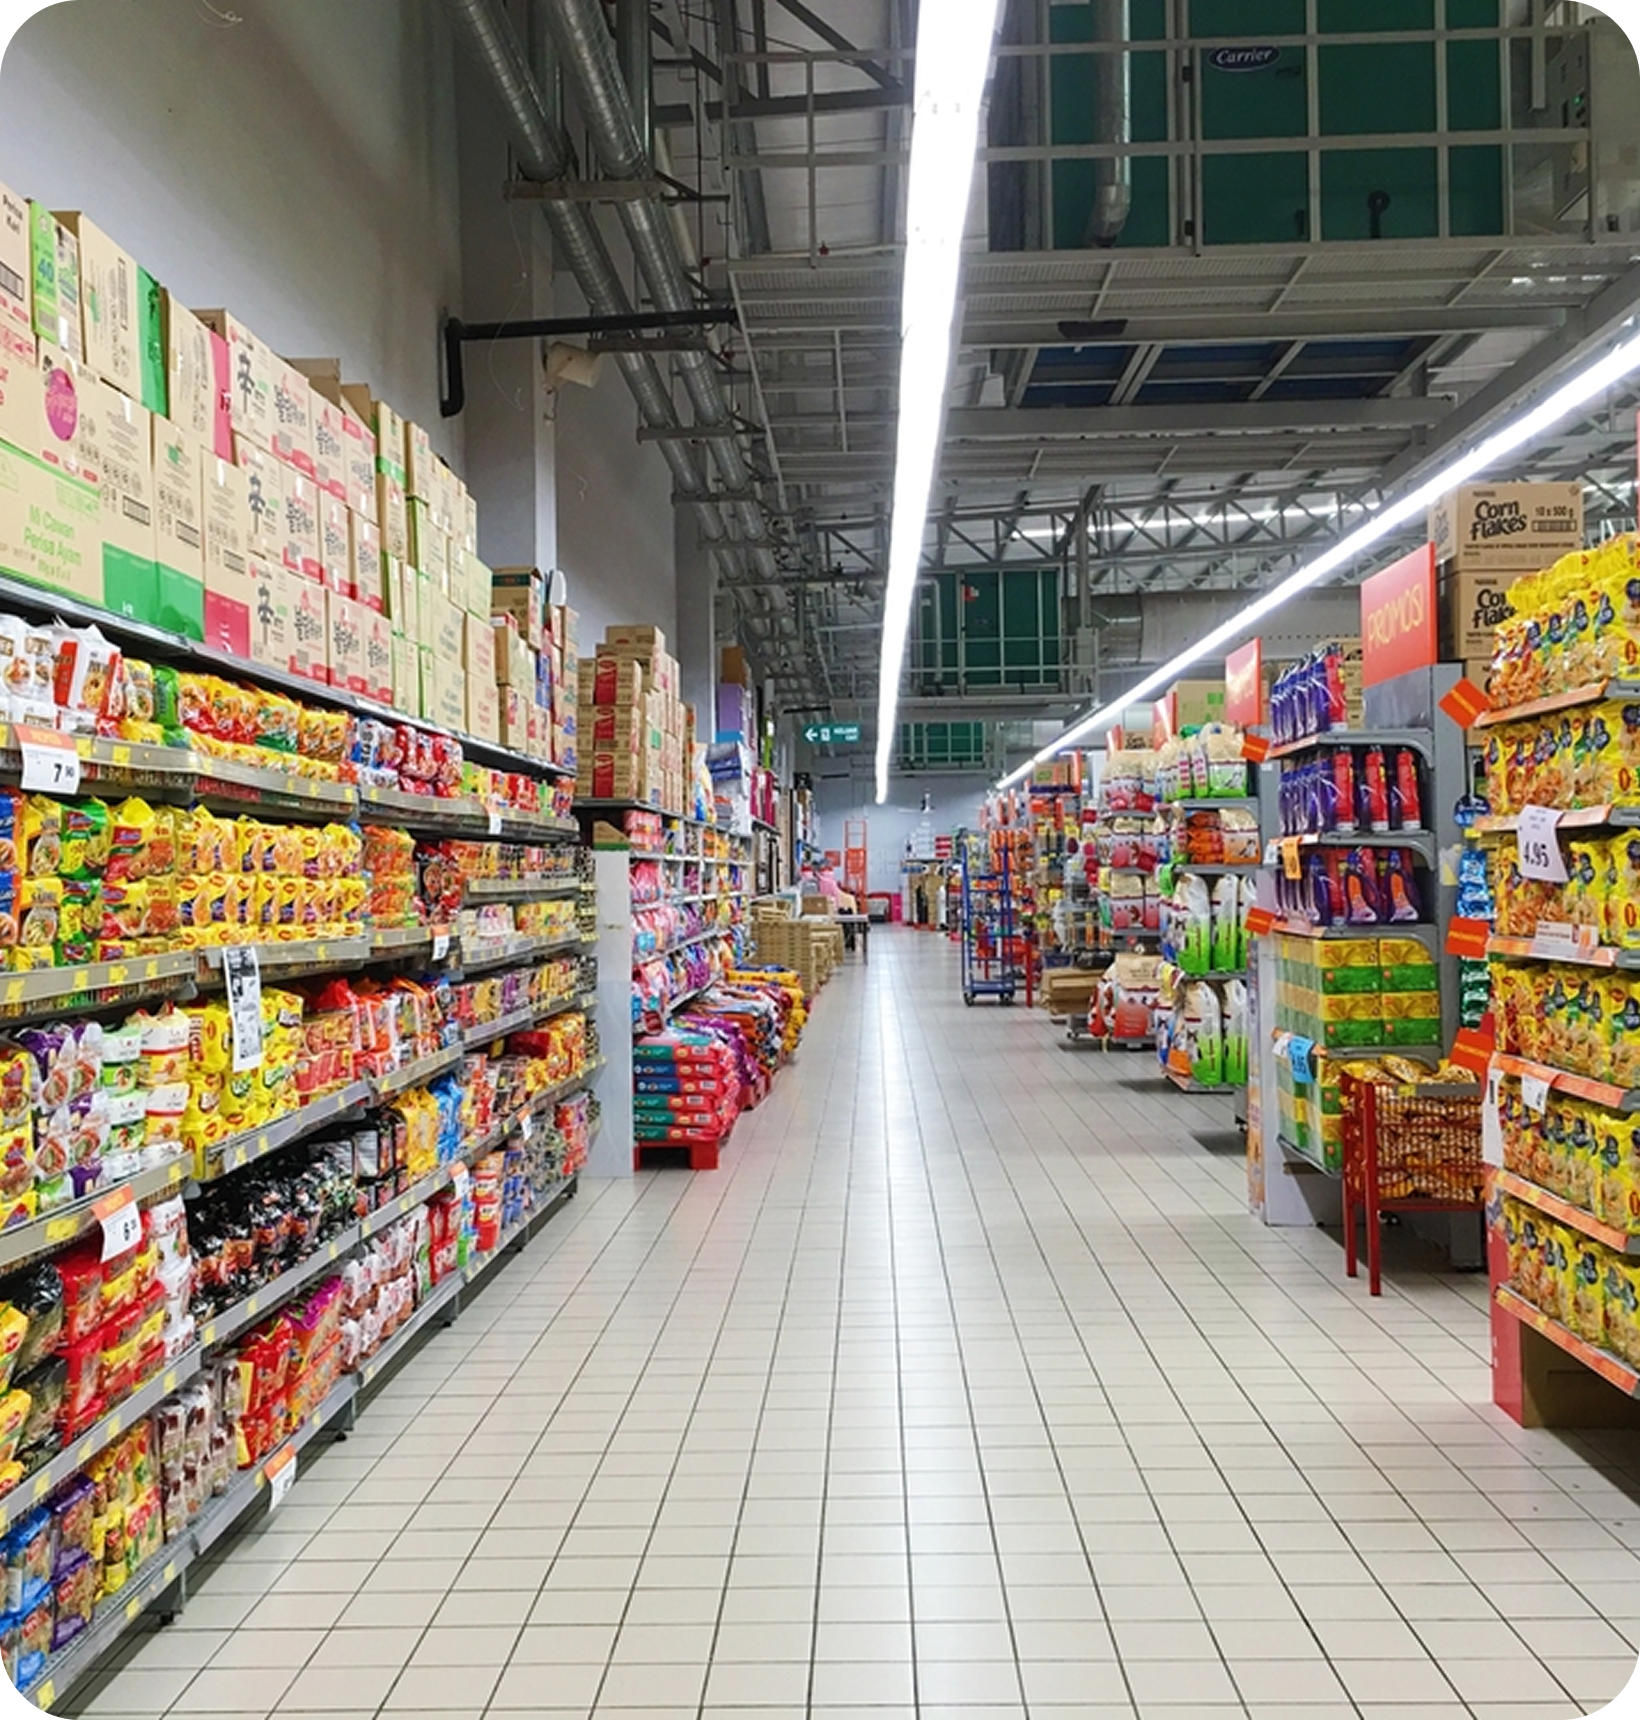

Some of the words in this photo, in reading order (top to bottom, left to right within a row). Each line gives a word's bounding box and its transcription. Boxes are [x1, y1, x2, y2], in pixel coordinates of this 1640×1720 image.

[1216, 48, 1272, 65] Carrier
[1475, 500, 1519, 521] Corn
[1535, 506, 1545, 516] 10
[1553, 505, 1567, 516] 500
[54, 763, 62, 783] 7
[1523, 841, 1550, 868] 4.95
